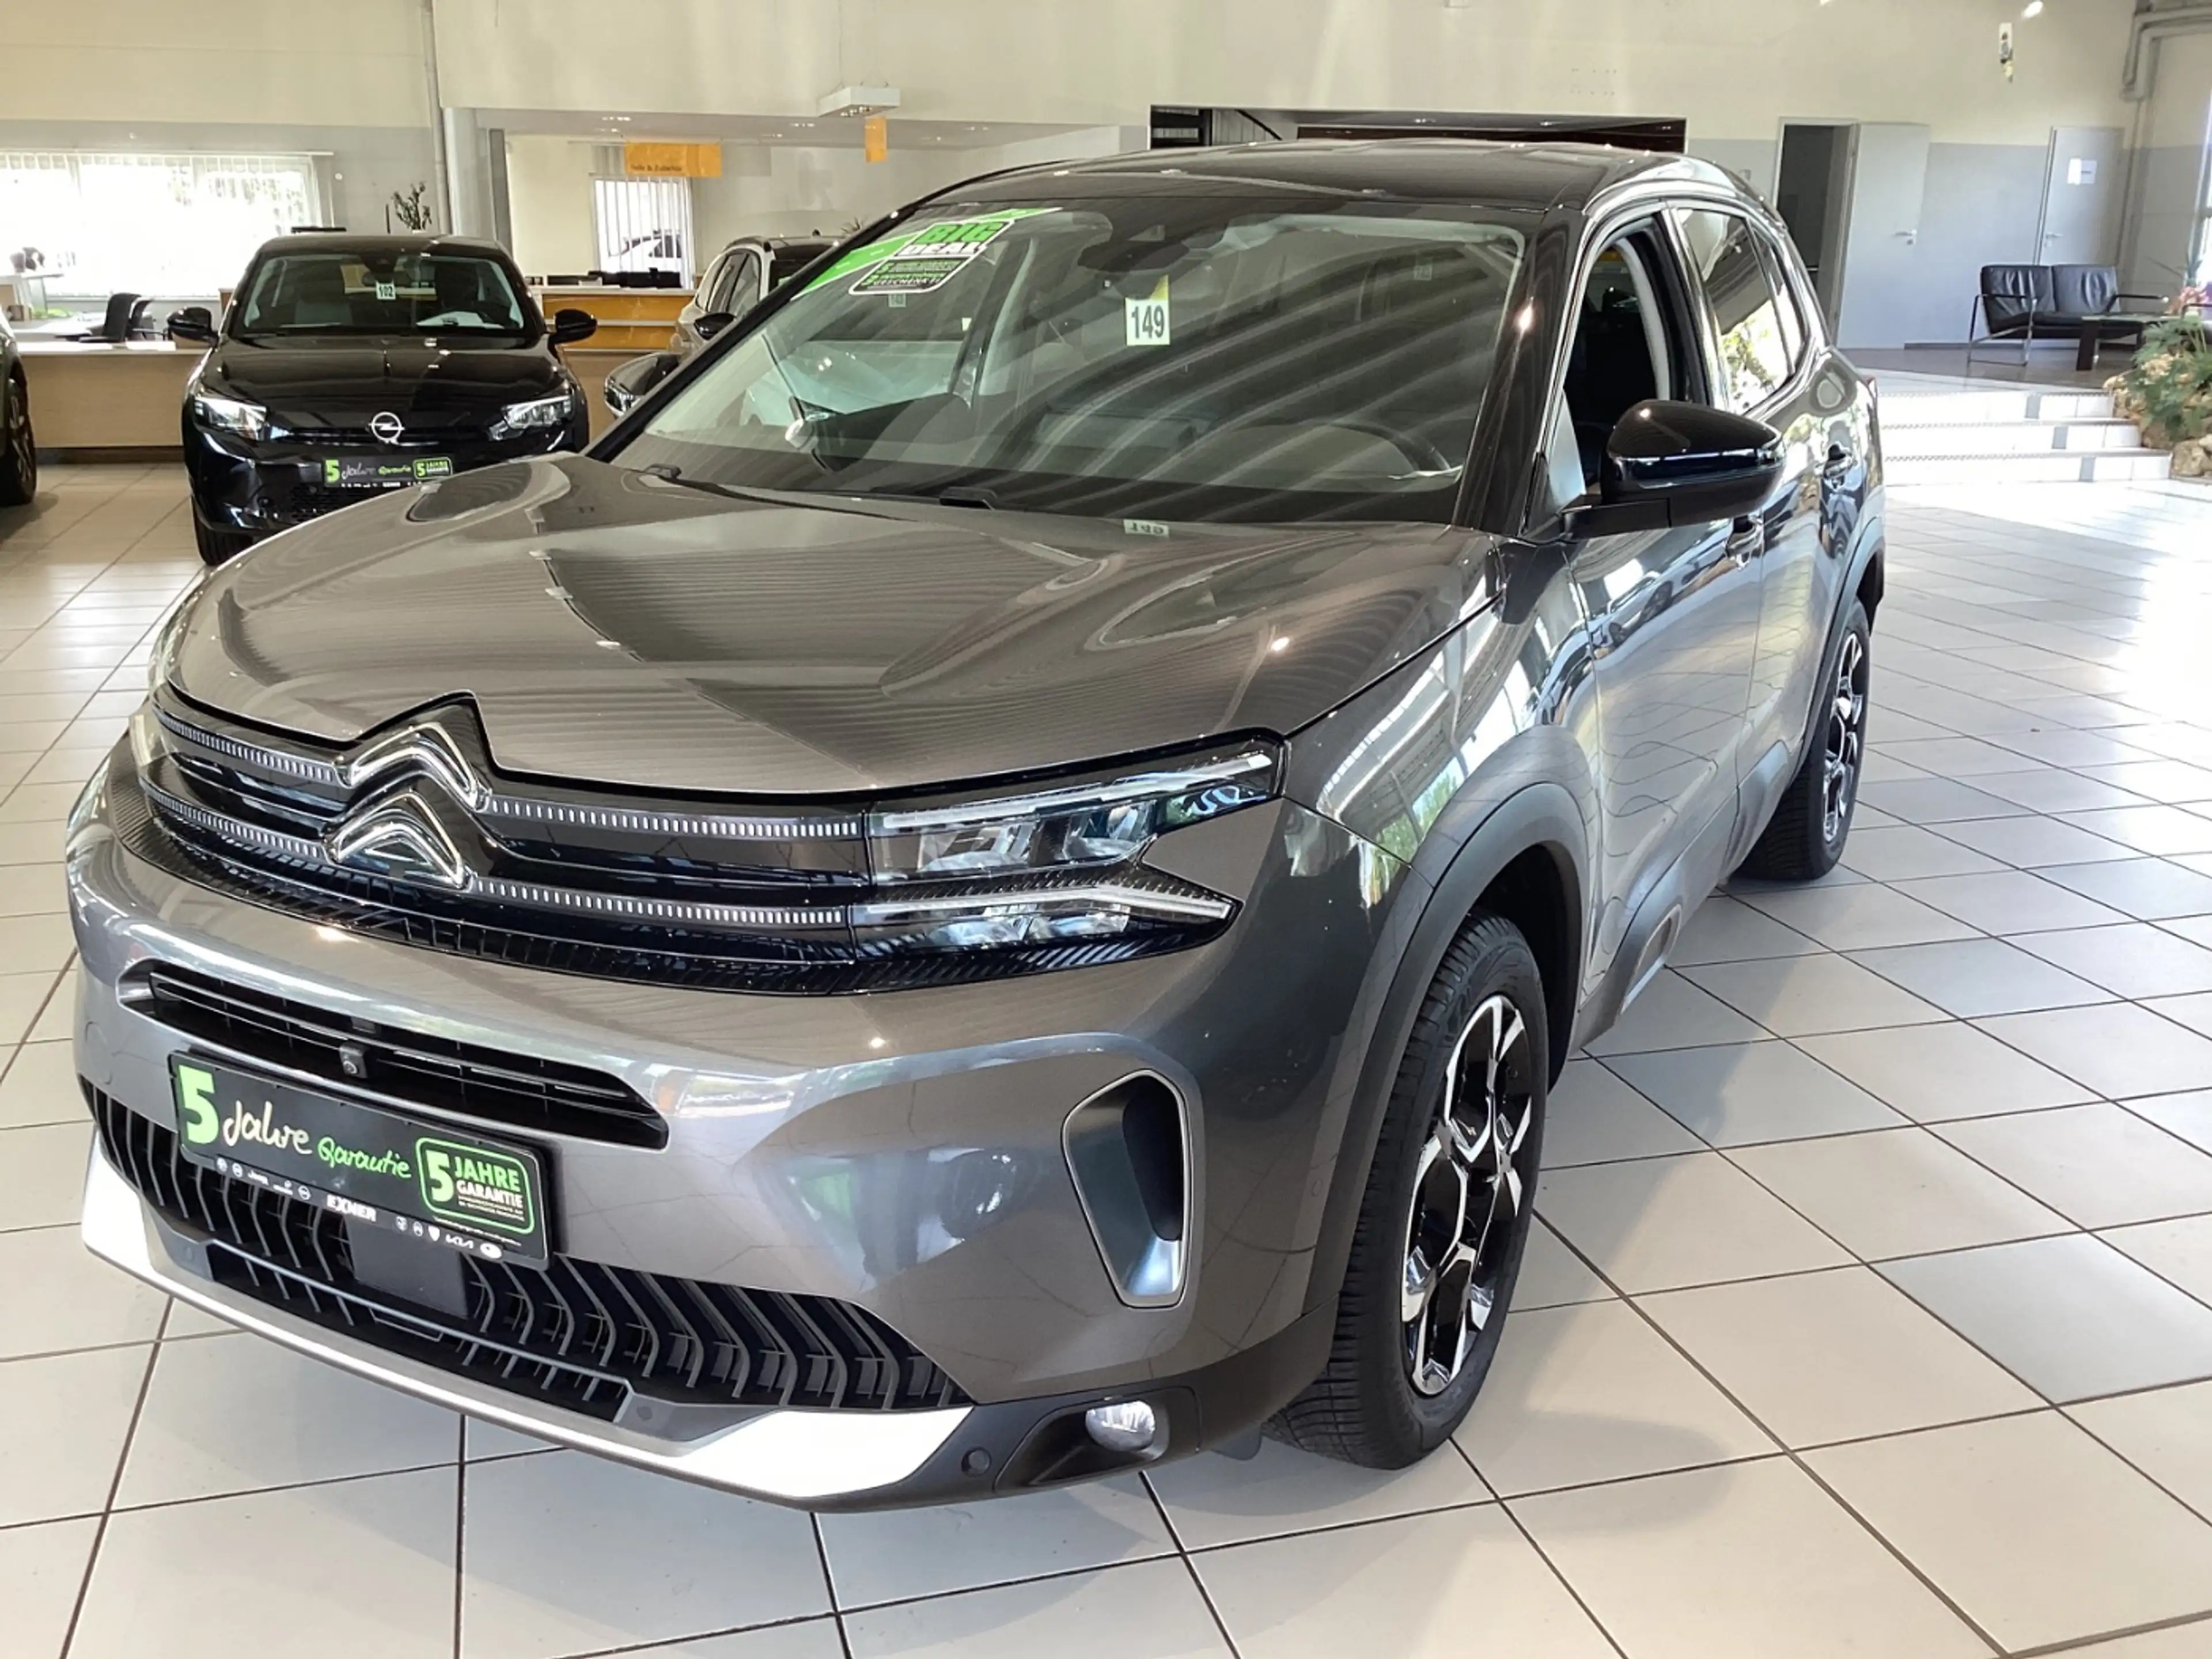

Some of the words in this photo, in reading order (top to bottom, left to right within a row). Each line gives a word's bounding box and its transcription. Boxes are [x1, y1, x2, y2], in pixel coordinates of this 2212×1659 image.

[914, 222, 1003, 244] BIG
[897, 242, 982, 255] DEAL
[1131, 305, 1164, 339] 149
[325, 460, 340, 483] 5
[416, 463, 426, 477] 5
[179, 1065, 219, 1144] 5
[223, 1100, 313, 1154] Jahre
[317, 1137, 412, 1179] Garantie
[425, 1150, 454, 1202] 5
[454, 1156, 521, 1192] JAHRE
[326, 1194, 377, 1222] EXNER
[456, 1180, 524, 1209] GARANTIE
